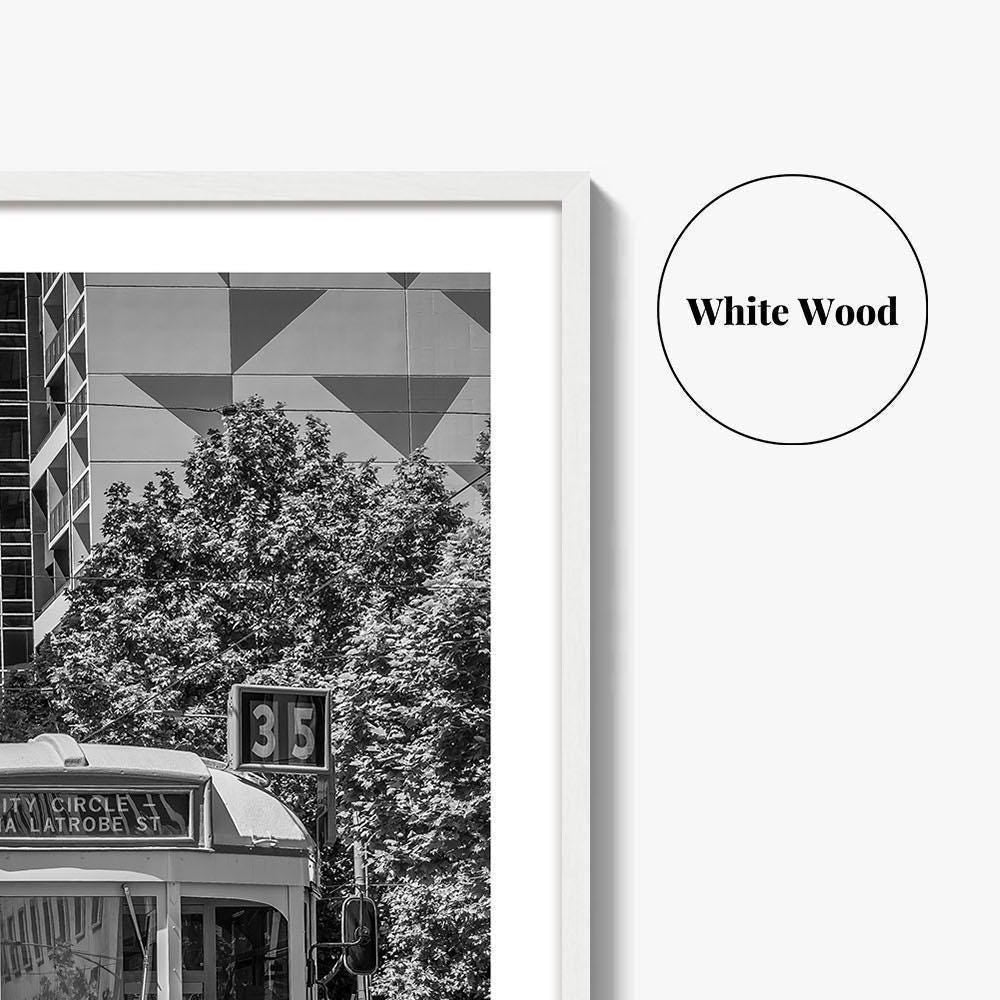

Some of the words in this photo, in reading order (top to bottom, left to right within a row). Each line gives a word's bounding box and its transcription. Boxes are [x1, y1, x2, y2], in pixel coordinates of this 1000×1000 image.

[251, 703, 315, 760] 35
[51, 796, 130, 813] CIRCLE
[30, 816, 124, 833] LATROBE
[136, 815, 161, 832] ST
